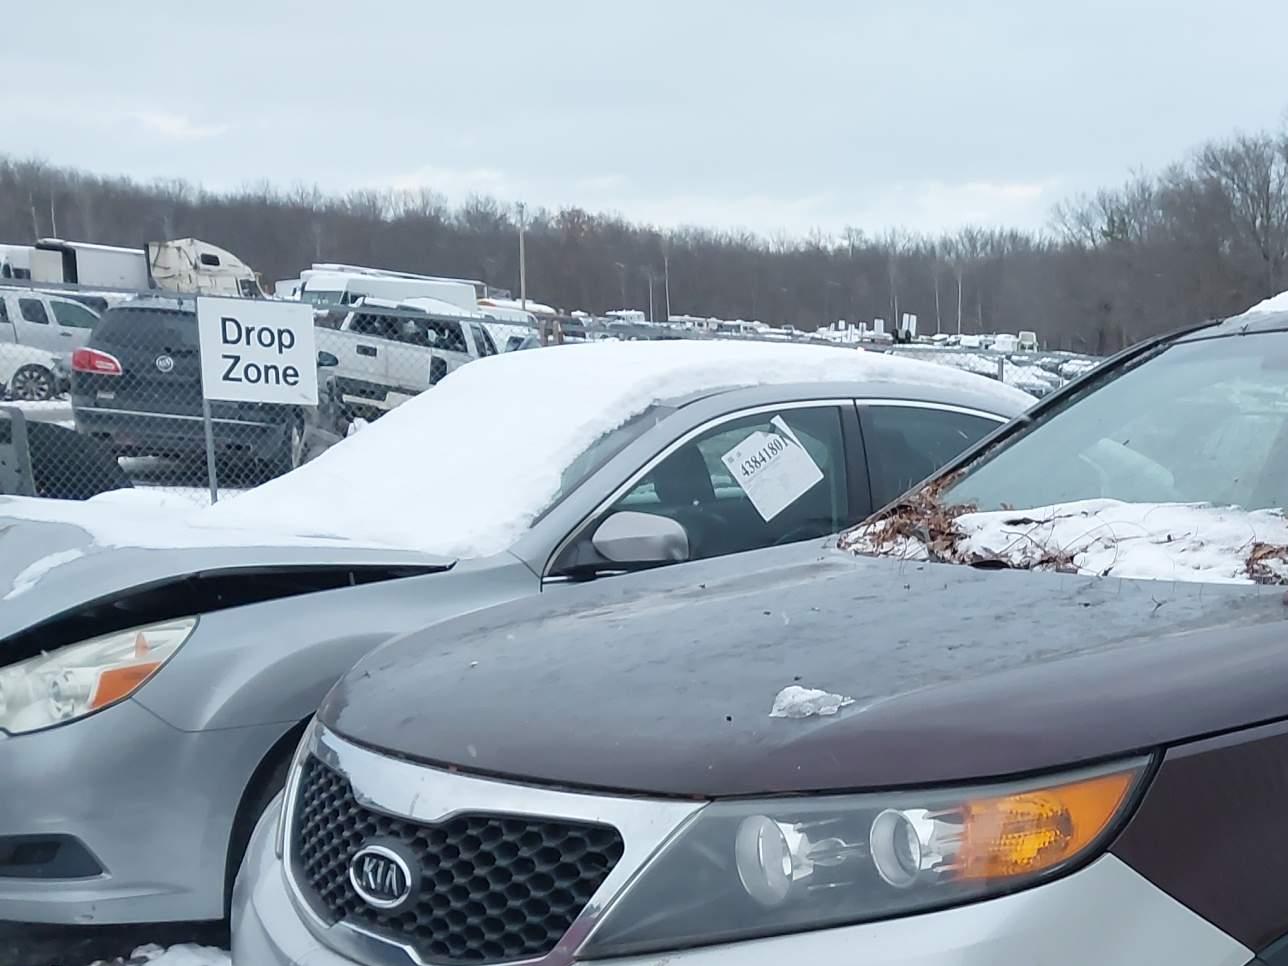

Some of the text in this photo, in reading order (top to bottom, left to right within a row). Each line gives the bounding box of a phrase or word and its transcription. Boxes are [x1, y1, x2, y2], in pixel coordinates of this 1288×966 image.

[220, 316, 296, 355] Drop
[221, 353, 300, 386] Zone
[740, 434, 790, 478] 43841801
[361, 856, 399, 897] KIA
